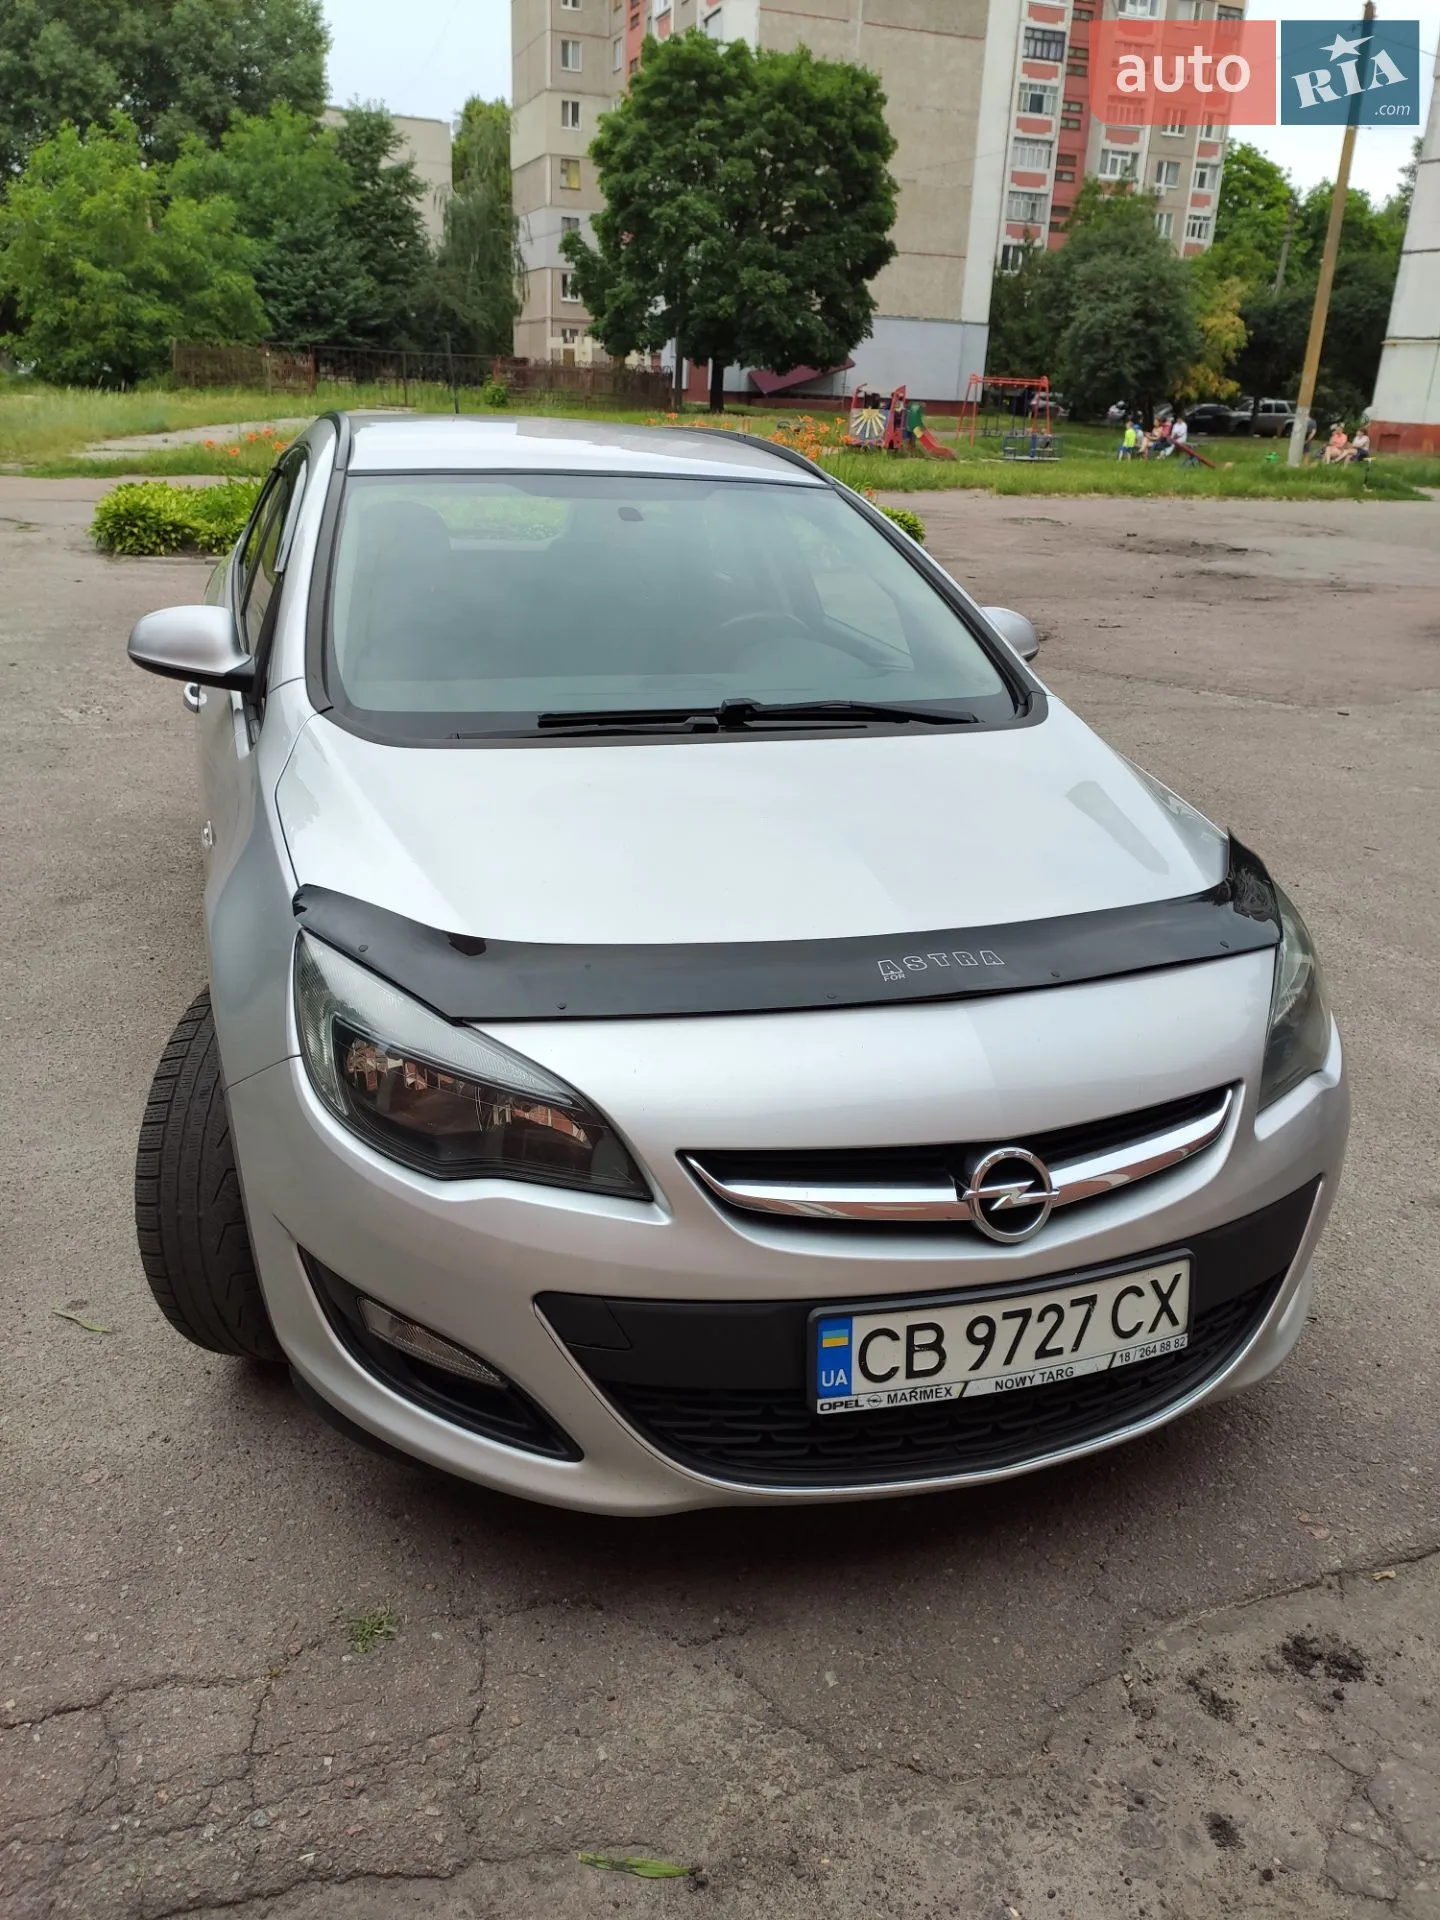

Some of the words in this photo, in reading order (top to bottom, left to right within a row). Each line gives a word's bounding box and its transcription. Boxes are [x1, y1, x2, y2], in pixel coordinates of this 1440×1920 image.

[877, 950, 1005, 976] ASTRA
[883, 973, 906, 982] FOR
[858, 1321, 947, 1383] CB
[966, 1294, 1098, 1371] 9727
[1111, 1273, 1182, 1339] CX
[819, 1399, 864, 1412] OPEL
[887, 1386, 953, 1405] MARIMEX
[995, 1374, 1036, 1391] NOWY
[1041, 1366, 1074, 1383] TARG
[1119, 1352, 1131, 1363] 18
[1139, 1345, 1157, 1358] 264
[1160, 1341, 1171, 1353] 88
[1174, 1337, 1186, 1348] 82
[821, 1368, 848, 1387] UA
